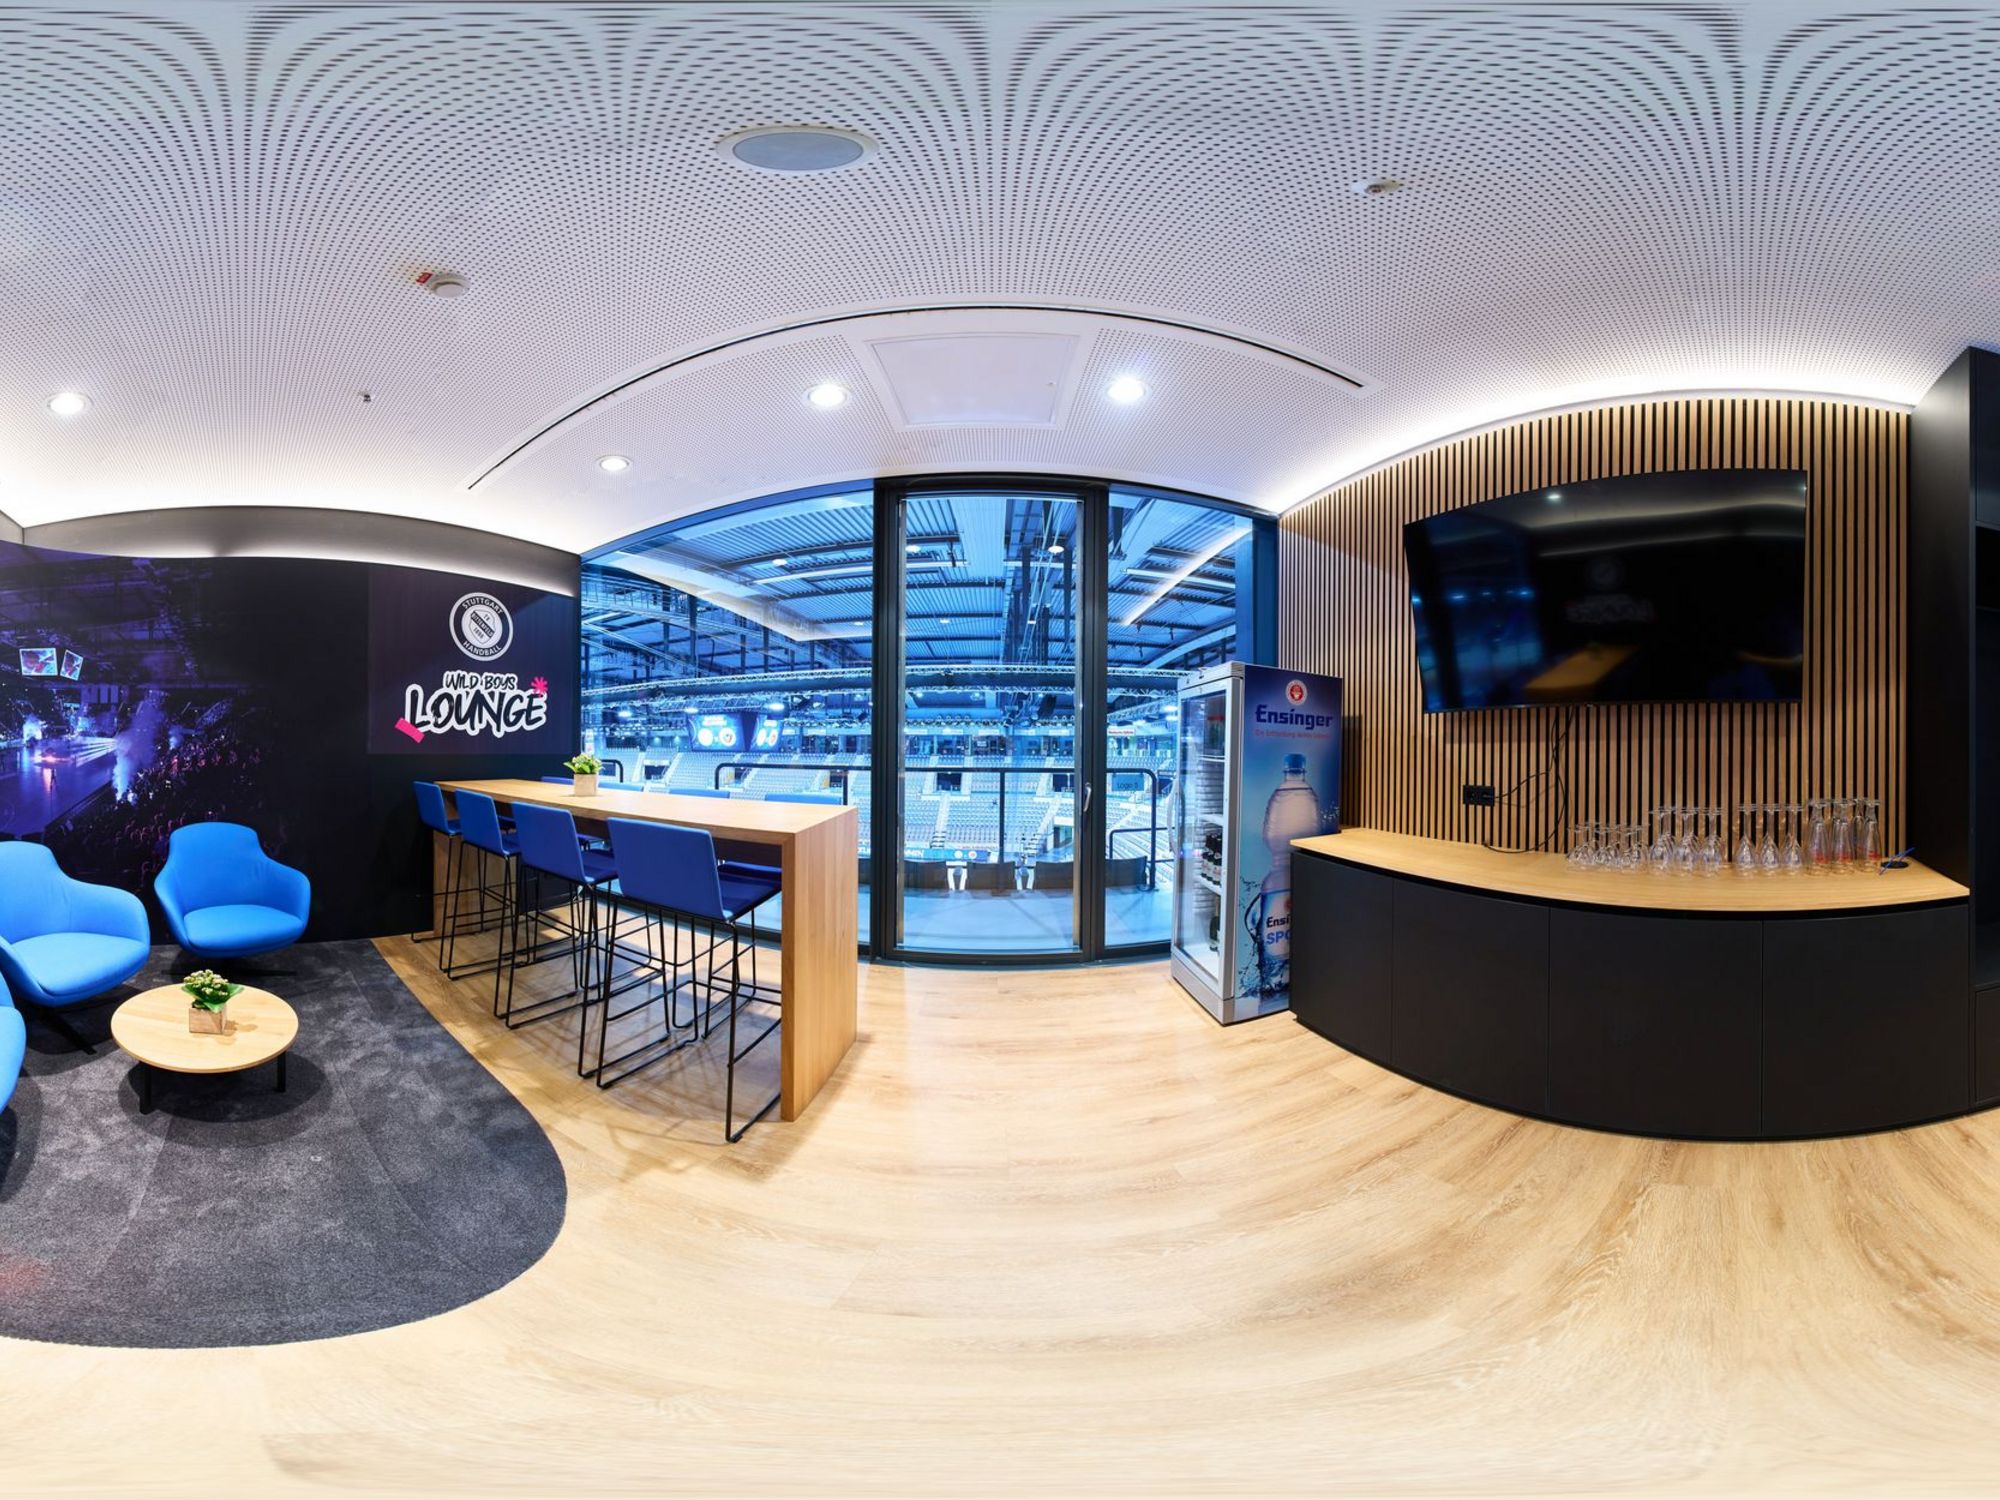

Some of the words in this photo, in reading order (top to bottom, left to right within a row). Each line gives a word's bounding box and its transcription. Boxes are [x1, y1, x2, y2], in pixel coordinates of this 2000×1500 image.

[462, 597, 503, 614] STUTTGART
[463, 640, 502, 656] HANDBALL
[445, 672, 480, 691] WILD
[483, 674, 517, 691] BOYS
[408, 687, 545, 734] LOUNGE
[1255, 704, 1333, 730] Ensinger
[1266, 914, 1292, 928] Ensi
